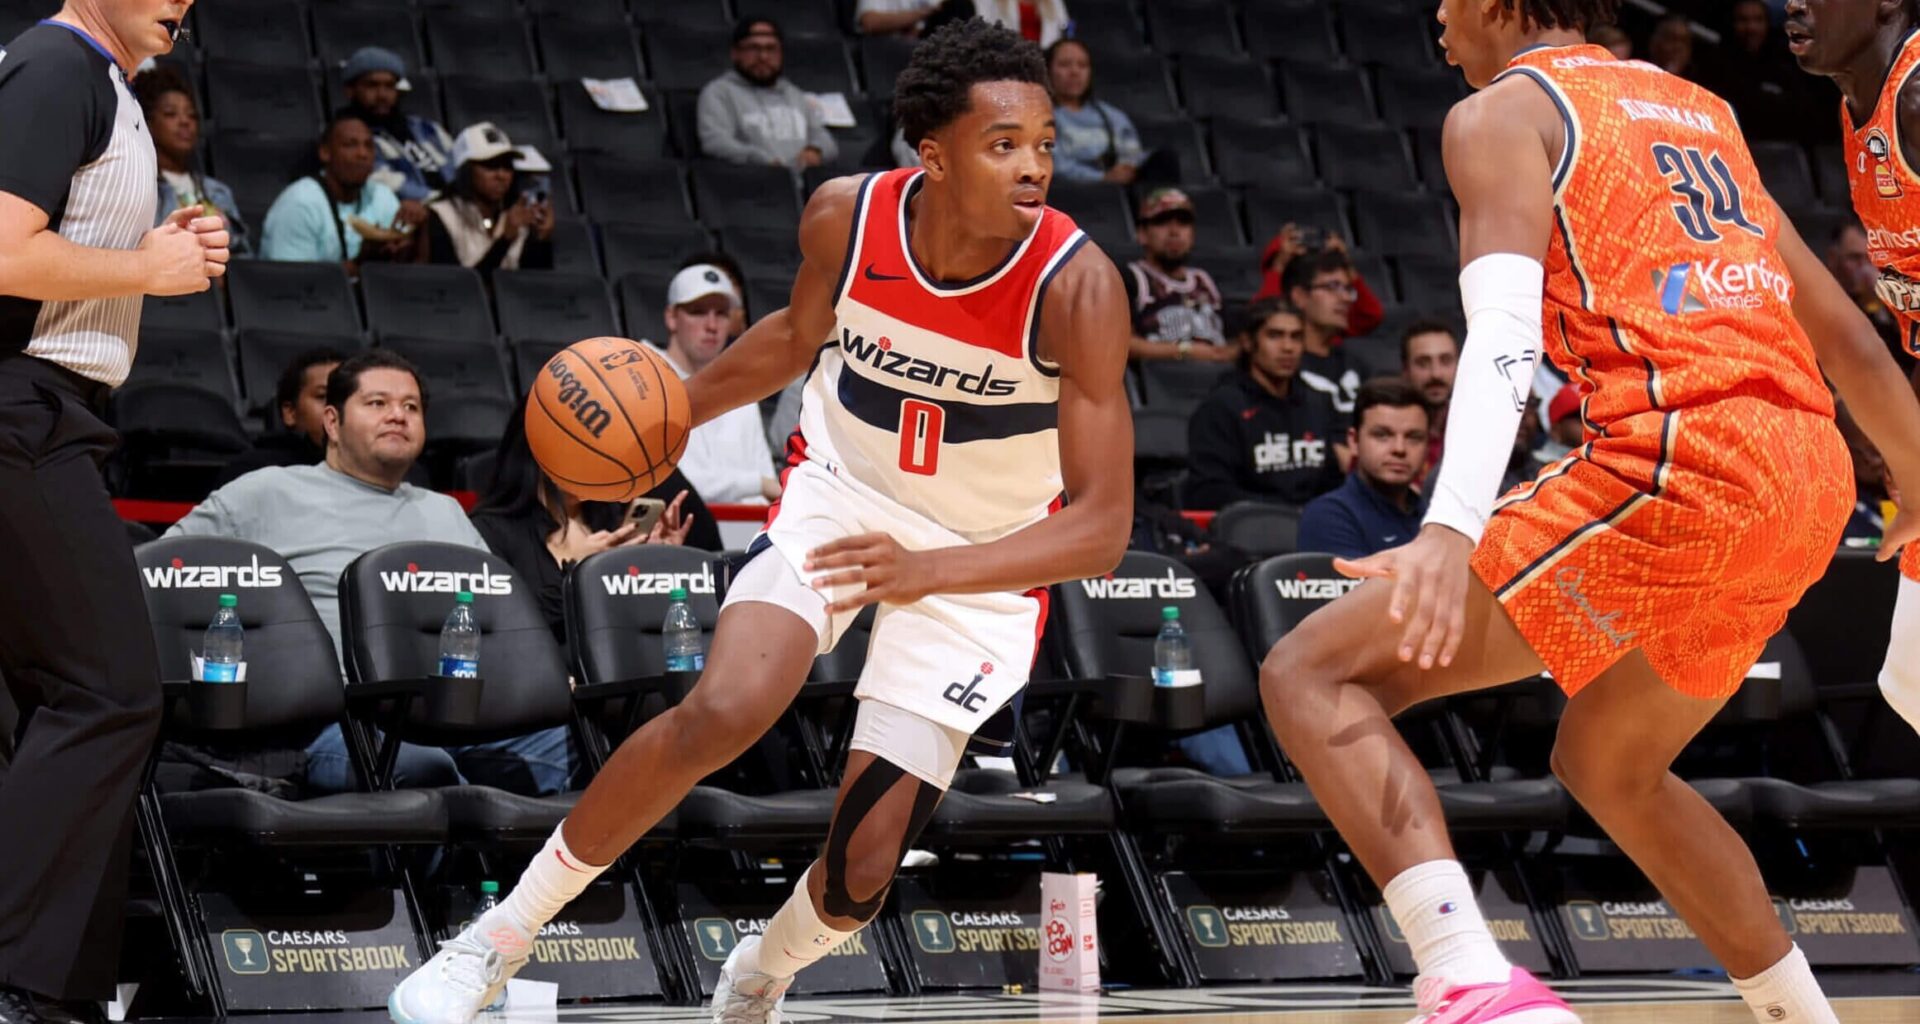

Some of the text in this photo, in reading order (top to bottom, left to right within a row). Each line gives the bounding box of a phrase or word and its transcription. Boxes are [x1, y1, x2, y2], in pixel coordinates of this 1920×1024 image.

[1651, 141, 1765, 243] 34
[1694, 257, 1790, 304] Kenfro
[1707, 292, 1764, 310] Homes
[842, 327, 1022, 396] wizards
[547, 354, 612, 440] Wilson
[899, 397, 946, 476] 0
[143, 553, 283, 589] wizards
[380, 561, 513, 595] wizards
[602, 560, 716, 595] wizard
[1082, 567, 1197, 599] wizards
[1275, 570, 1365, 599] wizar
[539, 920, 582, 937] SARS
[956, 927, 1040, 953] SPORTSB
[1229, 920, 1344, 946] SPORTSBOOK
[1799, 913, 1907, 935] SPORTSBOOK
[273, 944, 410, 973] SPORTSBOOK
[530, 936, 641, 963] ORTSBOOK
